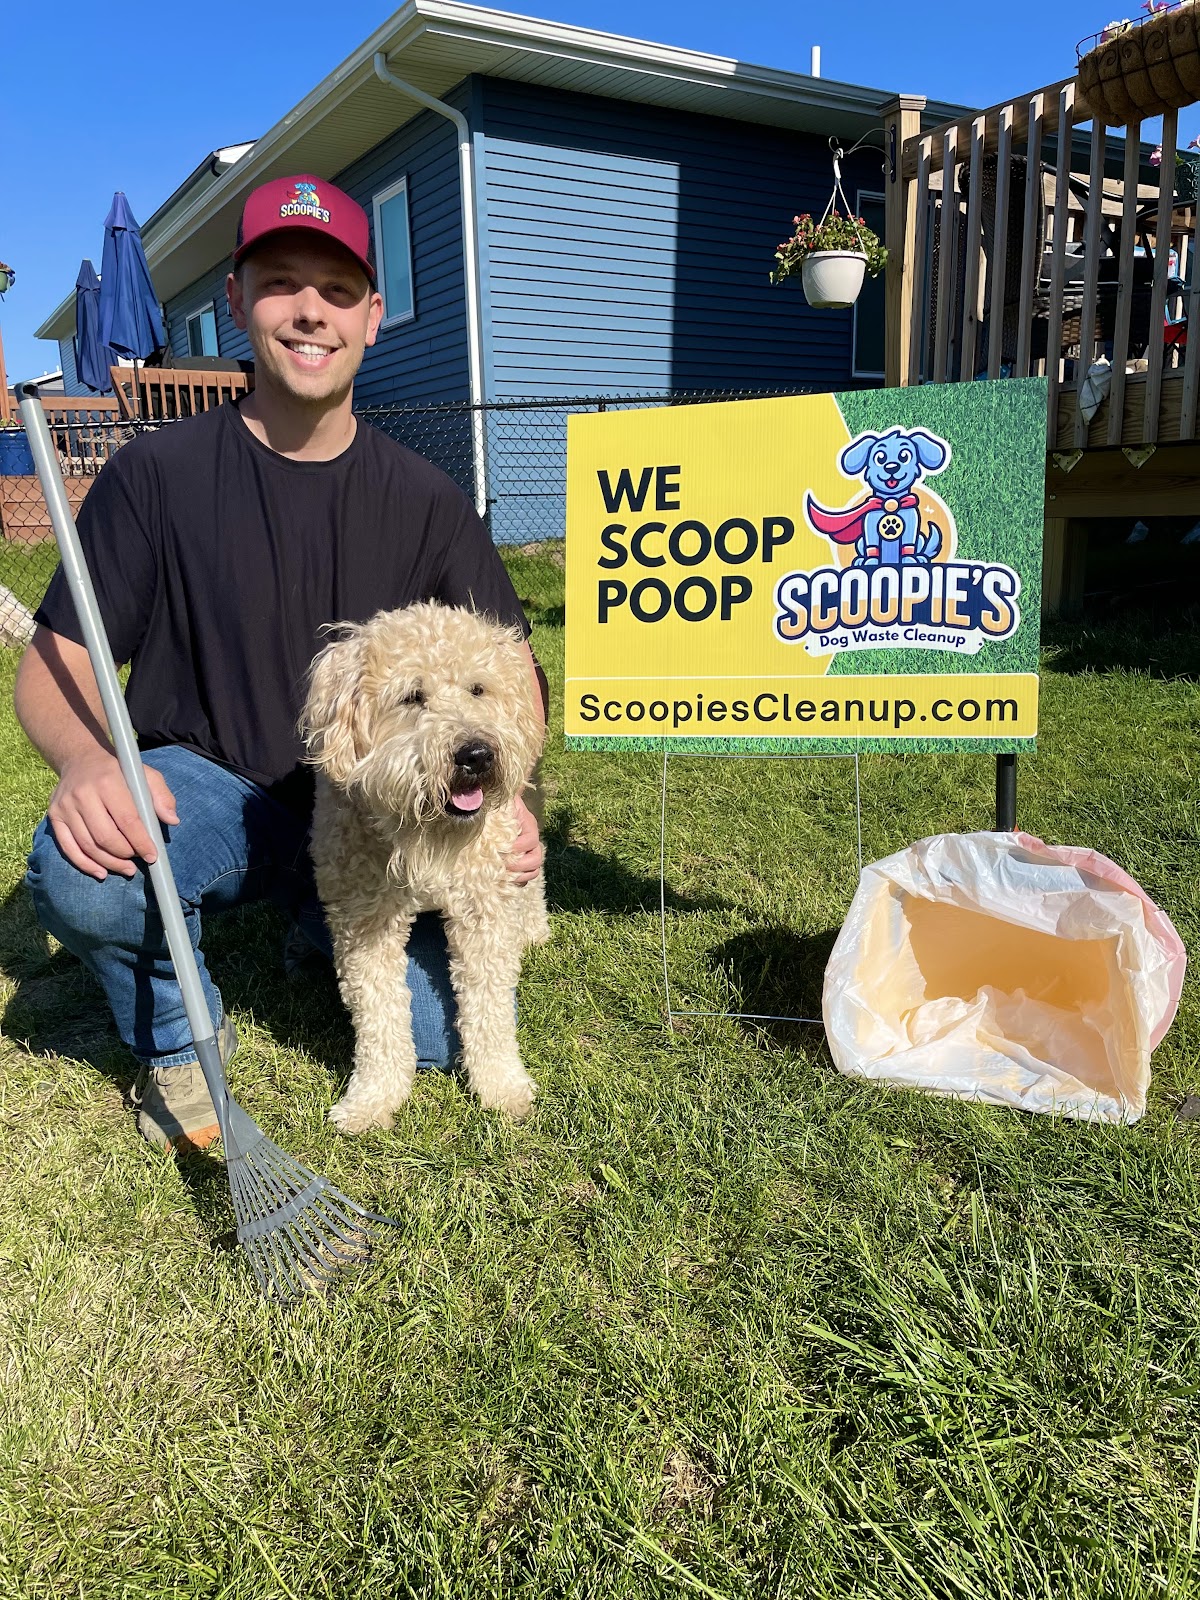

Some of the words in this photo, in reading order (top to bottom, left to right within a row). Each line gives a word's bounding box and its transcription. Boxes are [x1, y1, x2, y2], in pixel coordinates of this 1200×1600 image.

[280, 203, 330, 223] SCOOPIE'S
[597, 465, 681, 514] WE
[597, 516, 795, 569] SCOOP
[597, 575, 753, 624] POOP
[779, 565, 1016, 640] SCOOPIE'S
[819, 632, 849, 650] Dog
[851, 629, 900, 646] Waste
[903, 628, 966, 647] Cleanup
[579, 693, 1019, 728] ScoopiesCleanup.com
